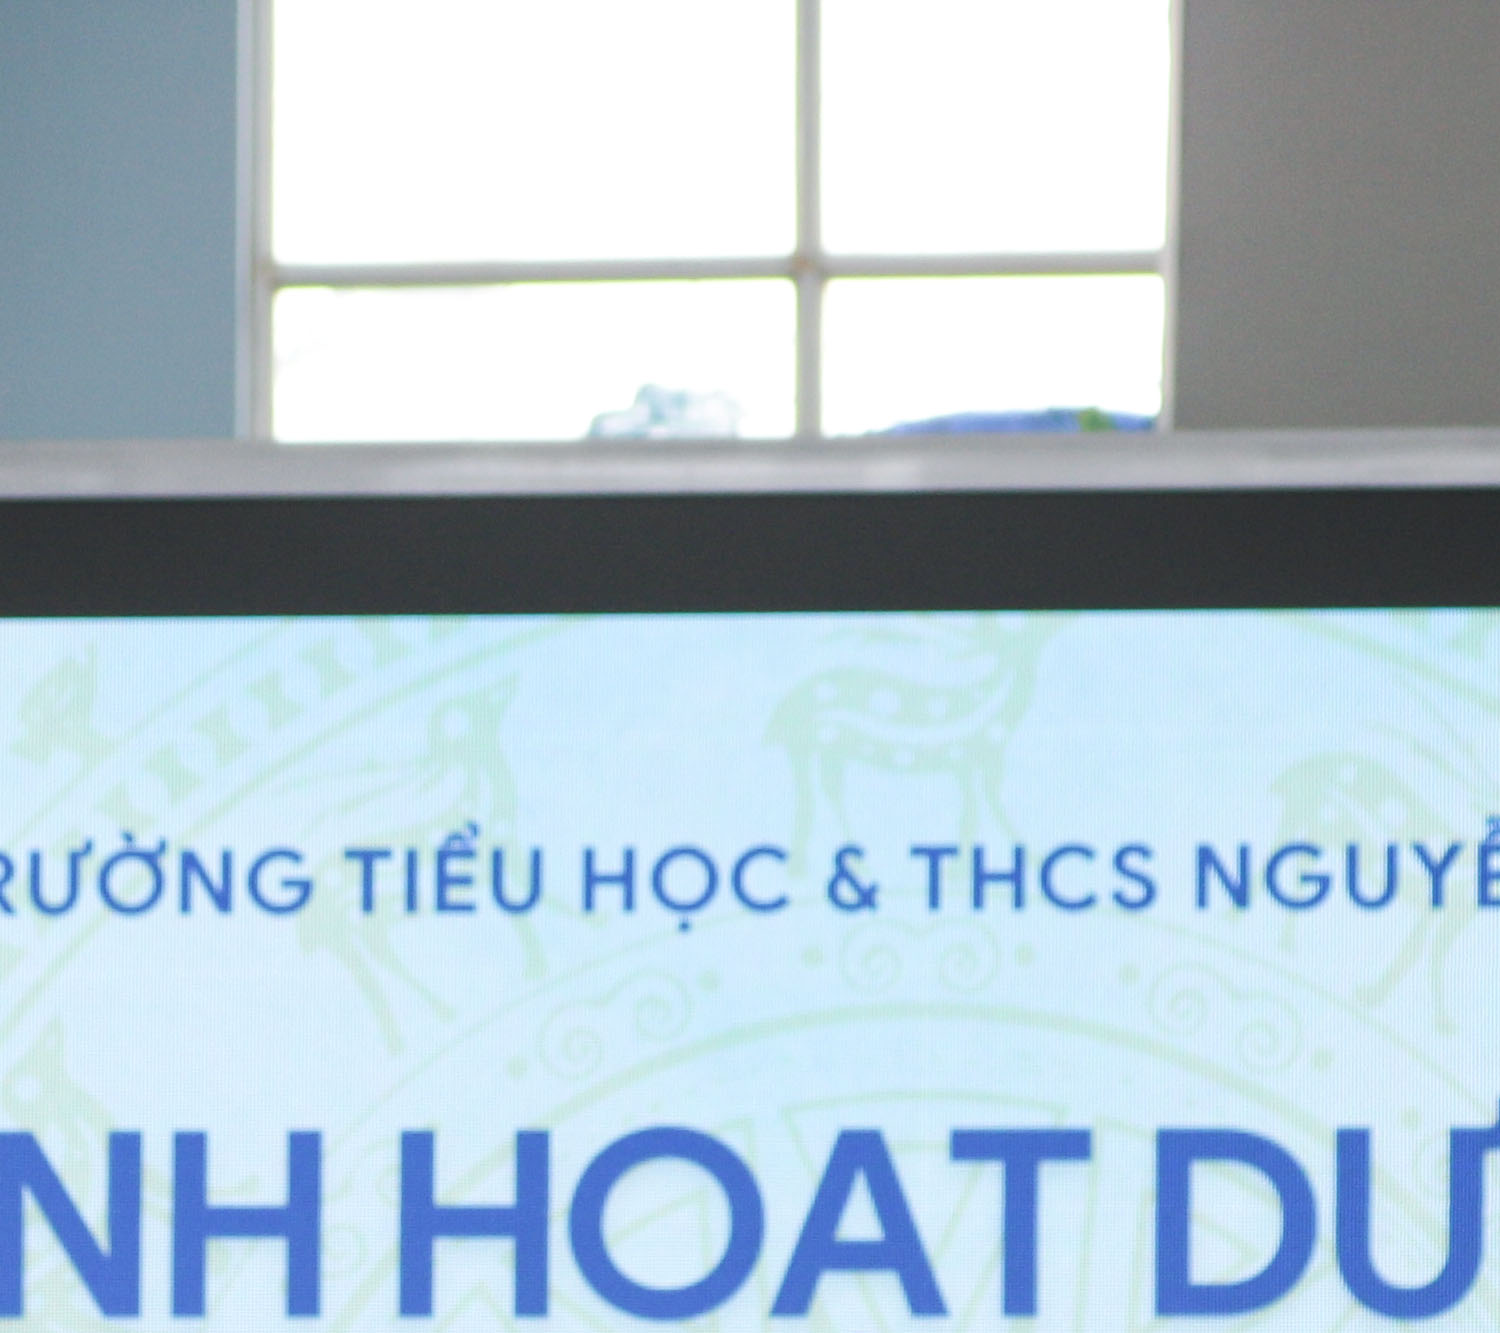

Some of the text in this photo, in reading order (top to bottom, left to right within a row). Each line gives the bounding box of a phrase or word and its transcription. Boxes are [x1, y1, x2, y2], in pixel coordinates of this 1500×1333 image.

[343, 821, 545, 917] TIỂU
[581, 844, 791, 933] HỌC
[826, 844, 880, 913] &
[909, 842, 1158, 912] THCS
